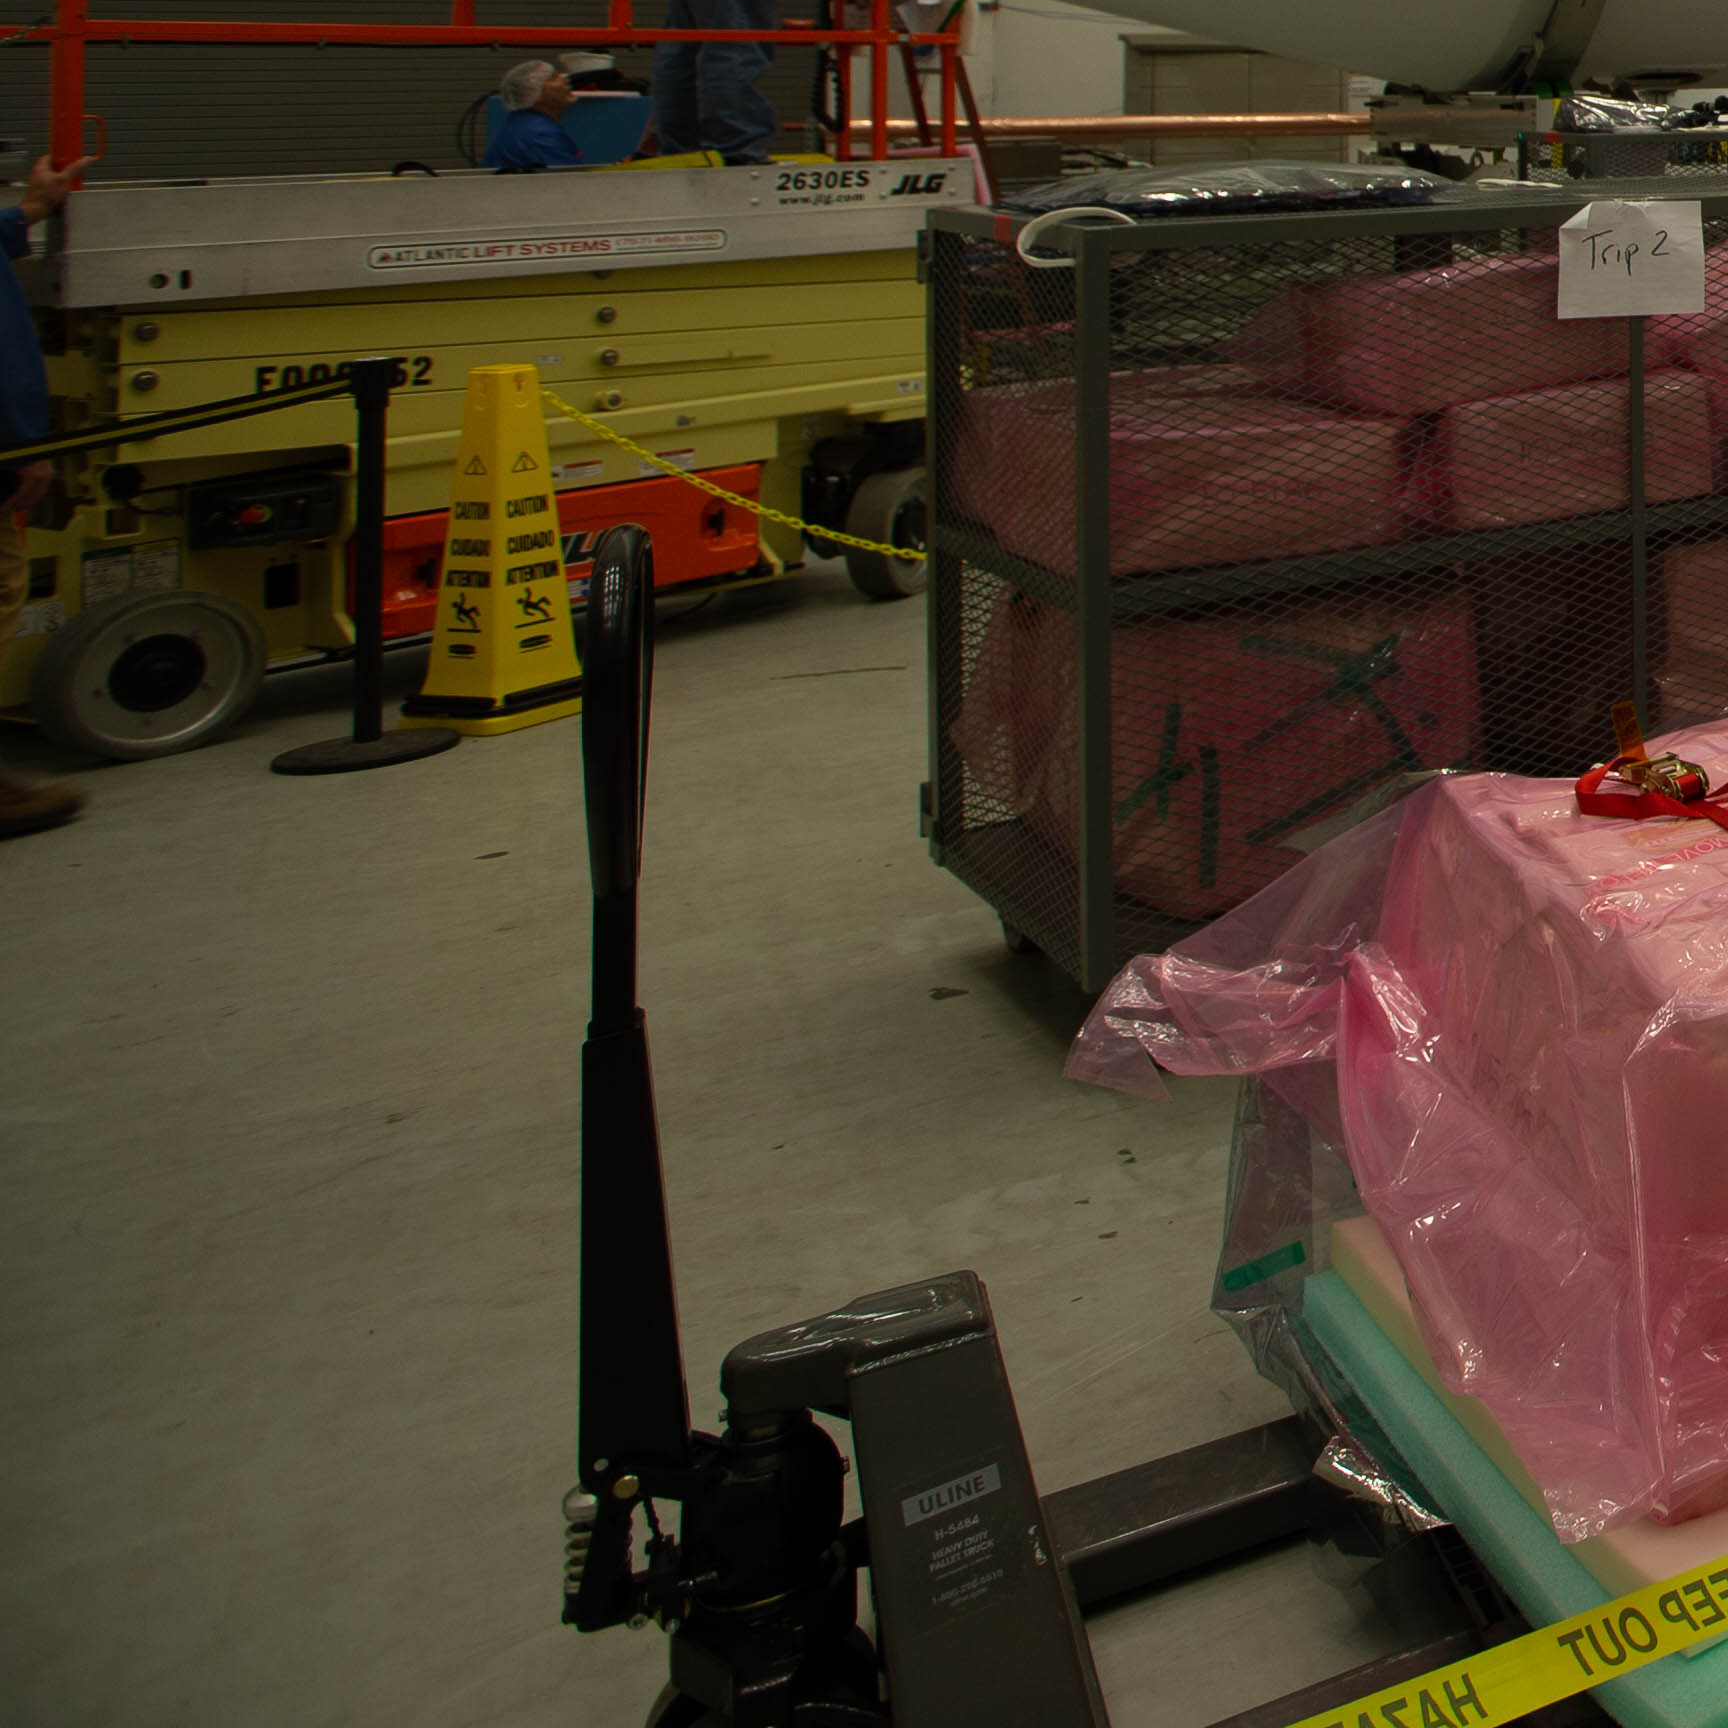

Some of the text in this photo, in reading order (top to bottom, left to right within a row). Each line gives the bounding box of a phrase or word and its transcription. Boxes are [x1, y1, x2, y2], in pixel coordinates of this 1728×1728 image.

[776, 170, 947, 195] 2630ES JLG
[779, 193, 865, 206] www.jlg.com
[396, 247, 471, 263] ATLANTIC
[474, 243, 515, 259] LIFT
[520, 239, 612, 257] SYSTEMS
[1582, 230, 1671, 277] Trip 2
[506, 494, 549, 519] CAUTION
[507, 529, 554, 555] CUIDADO
[505, 560, 559, 586] ATTENTION
[918, 1474, 986, 1514] ULINE
[928, 1552, 962, 1573] PALLET
[963, 1538, 996, 1558] TRUCK
[931, 1529, 989, 1561] HEAVY DUTY
